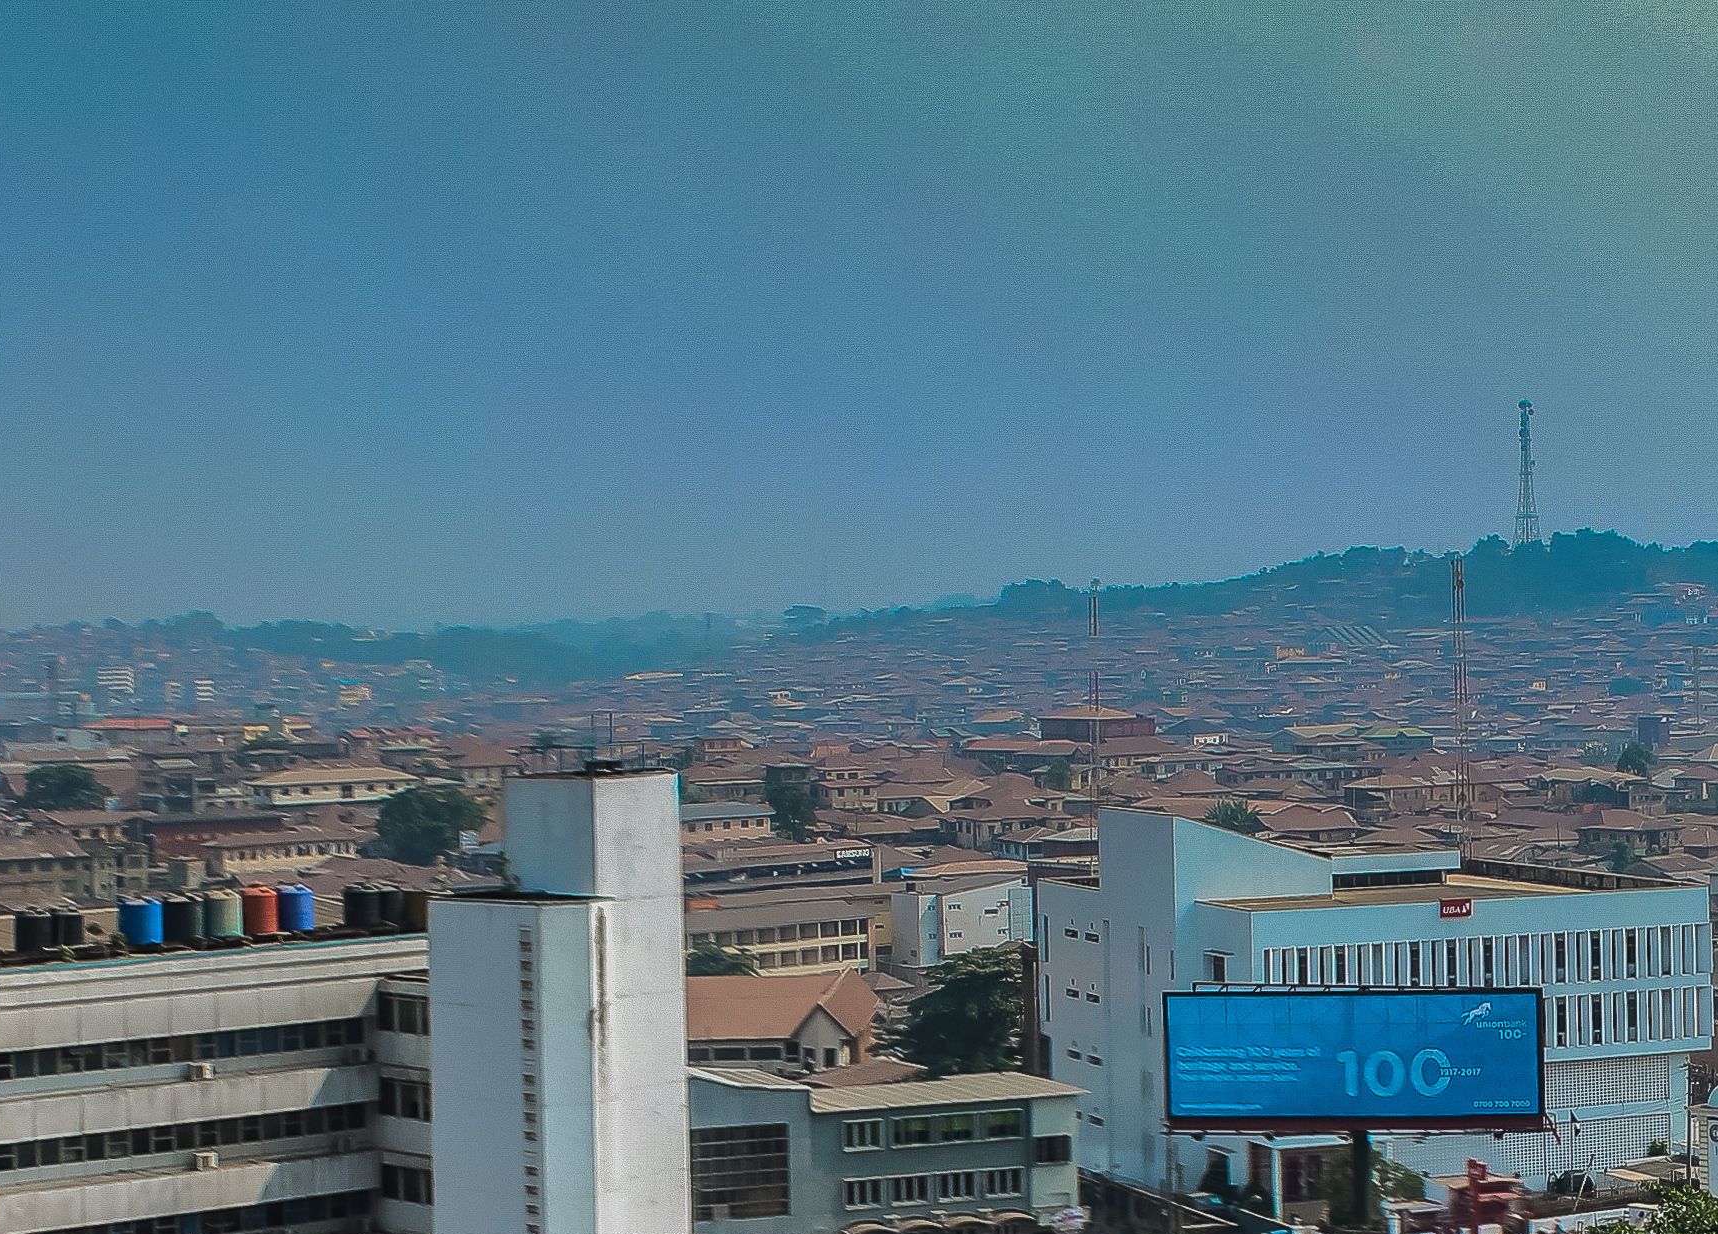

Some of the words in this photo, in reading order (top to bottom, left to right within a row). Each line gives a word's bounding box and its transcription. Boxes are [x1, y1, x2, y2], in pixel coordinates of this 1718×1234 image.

[1443, 906, 1461, 914] UBA
[1476, 1020, 1527, 1029] unionbank
[1335, 1049, 1451, 1098] 100
